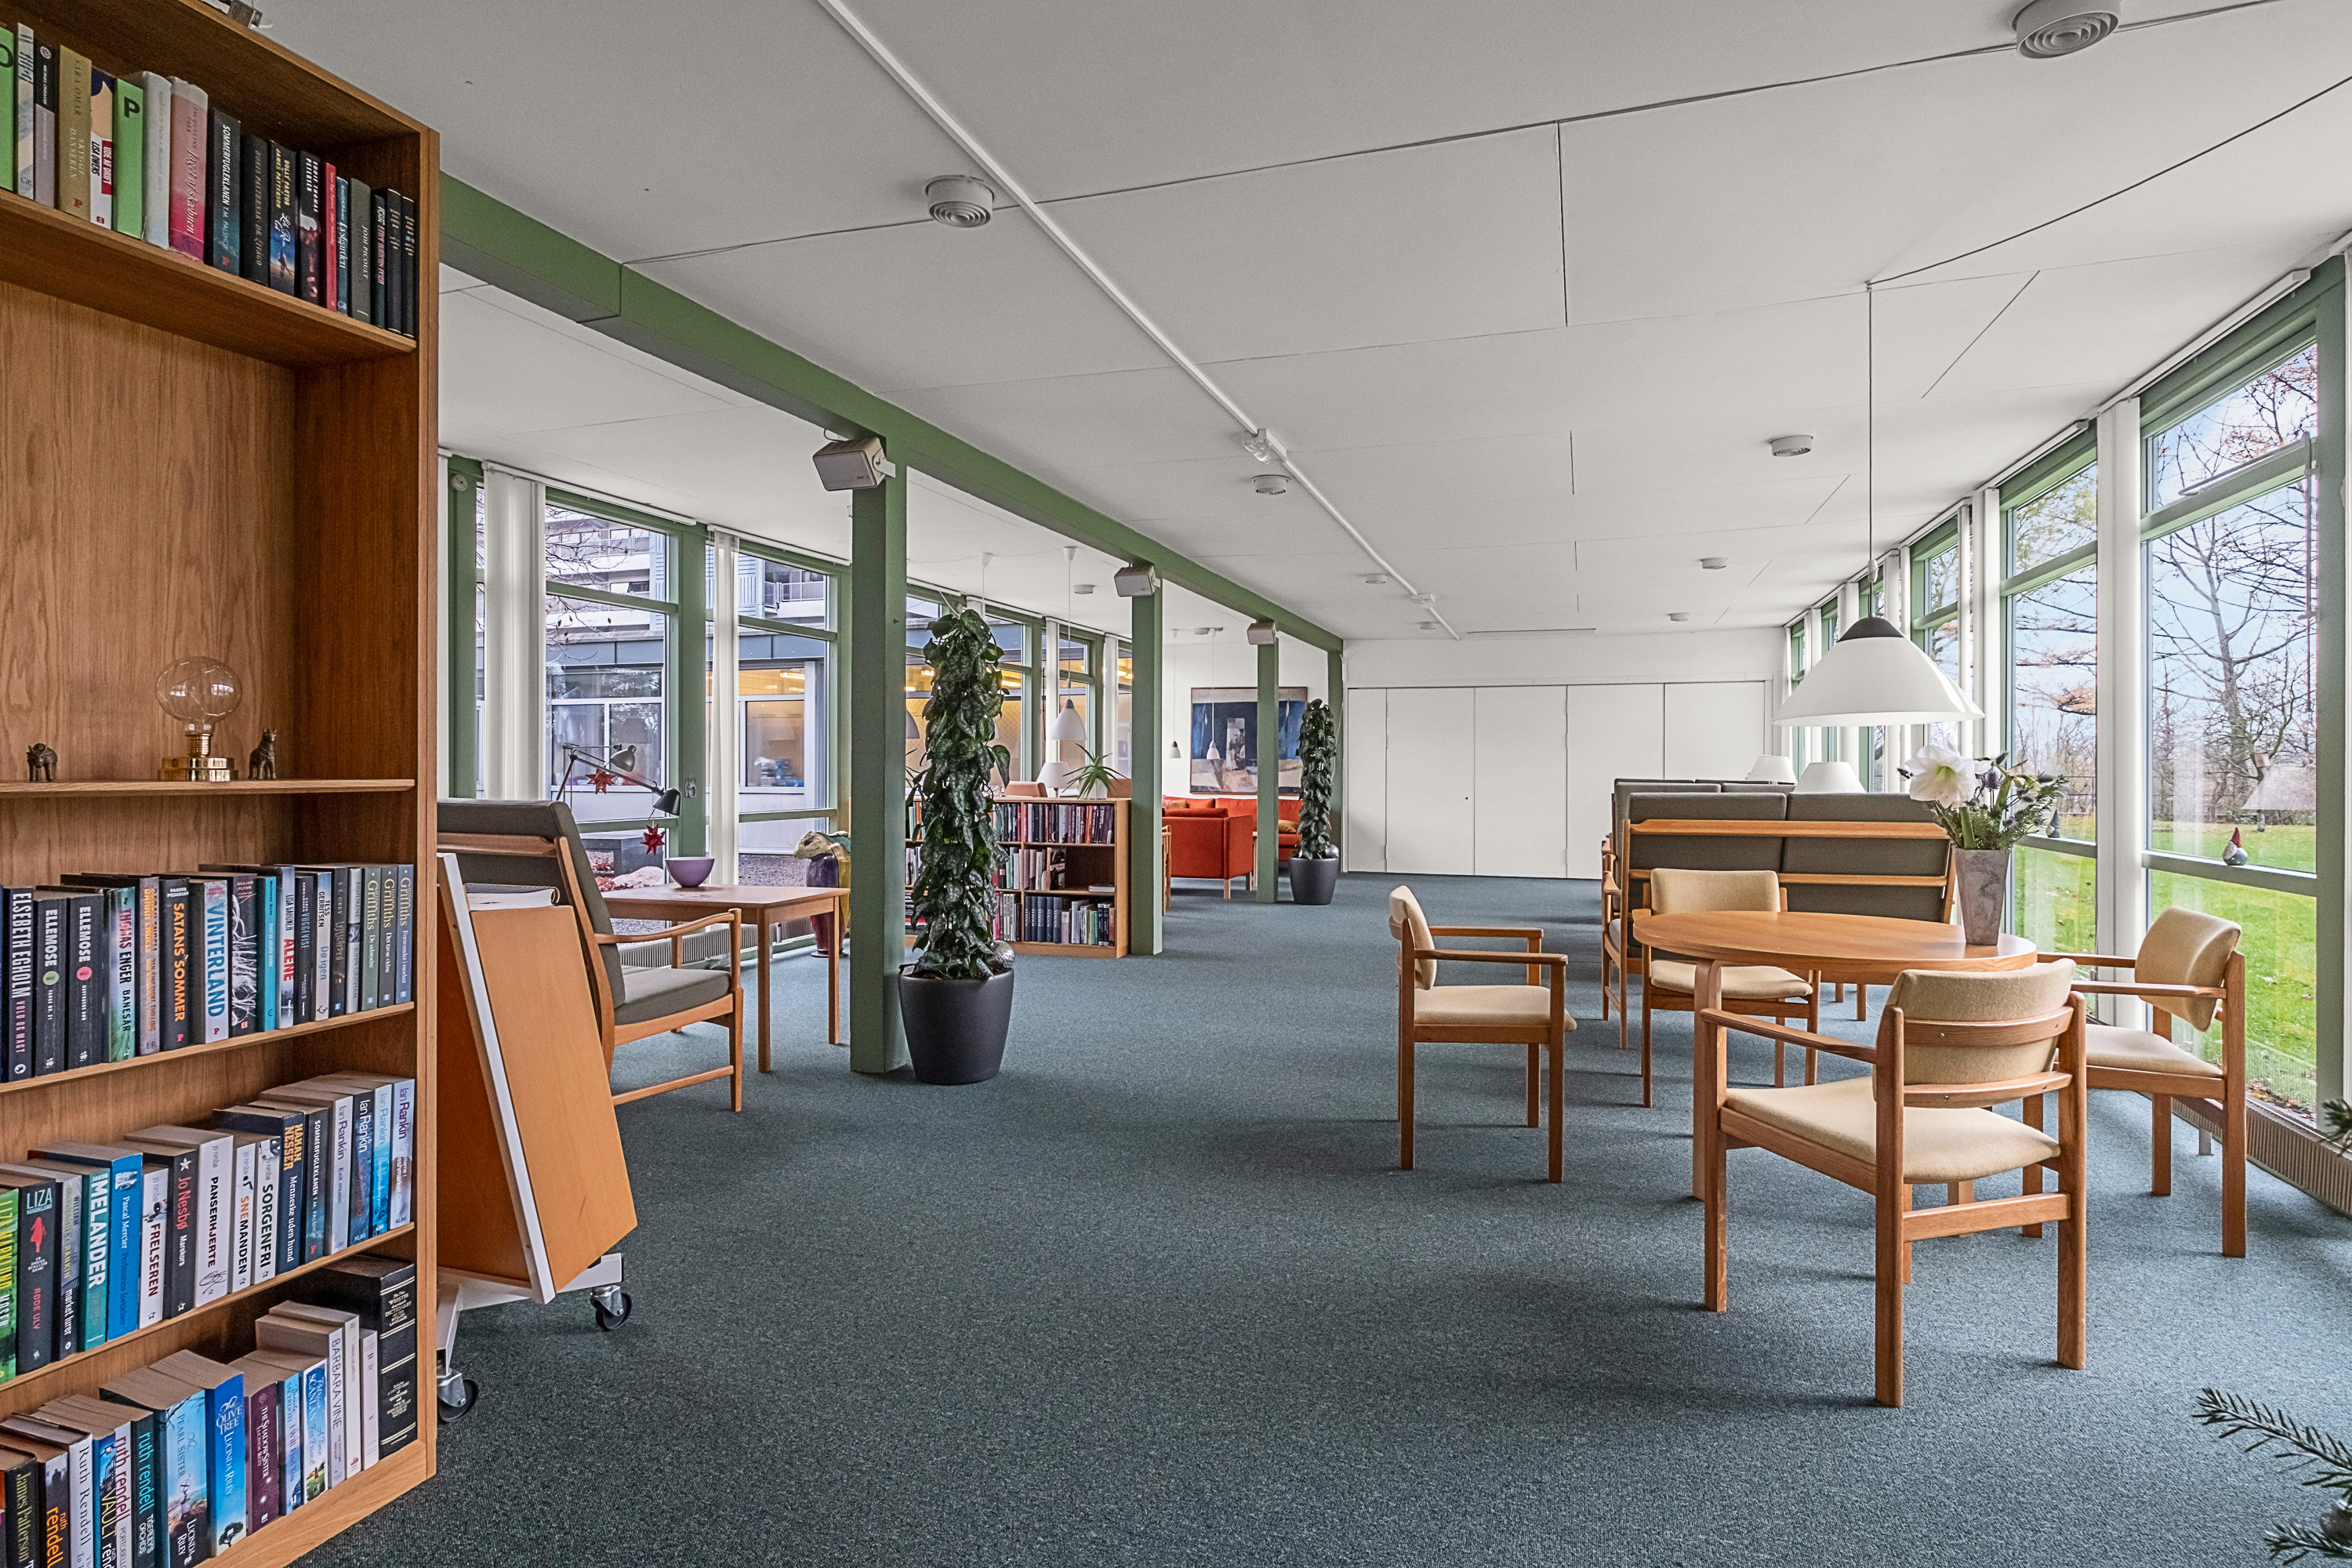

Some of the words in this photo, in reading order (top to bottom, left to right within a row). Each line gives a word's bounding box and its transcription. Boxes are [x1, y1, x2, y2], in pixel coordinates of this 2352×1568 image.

[124, 96, 141, 118] P
[92, 141, 100, 156] LISA
[92, 154, 100, 176] OWENS
[103, 146, 111, 158] UDE
[103, 158, 111, 166] AF
[185, 147, 199, 180] Jaget
[103, 166, 111, 185] DRIFT
[184, 177, 198, 196] af
[187, 191, 198, 234] skæbnen
[144, 888, 158, 920] SARAH
[285, 895, 294, 906] LISA
[366, 880, 379, 931] Griffiths
[383, 878, 395, 928] Griffiths
[400, 877, 411, 926] Griffiths
[12, 893, 31, 949] ELSEBETH
[78, 906, 91, 963] ELLEMOSE
[119, 908, 132, 949] THOMAS
[173, 902, 184, 956] SATANS
[285, 906, 294, 931] GARDNER
[301, 913, 310, 949] VUGGEVISE
[45, 909, 58, 967] ELLEMOSE
[144, 922, 158, 953] ENGELL
[369, 935, 376, 943] De
[12, 950, 31, 998] EGHOLM
[119, 951, 132, 984] ENGER
[146, 958, 156, 971] DEN
[207, 902, 225, 1017] VINTERLAND
[284, 938, 295, 982] ALENE
[318, 960, 328, 980] igen
[146, 970, 156, 1004] KINESISKE
[174, 960, 185, 1022] SOMMER
[16, 1000, 25, 1019] VOLD
[16, 1021, 25, 1031] OG
[146, 1004, 156, 1032] TVILLING
[16, 1033, 25, 1052] MAGT
[359, 1099, 371, 1116] Ian
[379, 1093, 388, 1108] Ian
[398, 1087, 409, 1102] Ian
[338, 1105, 347, 1120] Ian
[379, 1108, 388, 1145] Rankin
[398, 1102, 410, 1140] Rankin
[283, 1125, 295, 1171] NESSER
[337, 1120, 348, 1160] Rankin
[358, 1115, 371, 1153] Rankin
[312, 1120, 321, 1196] SOMMERFUGLEKLANEN
[27, 1187, 53, 1210] LIZA
[178, 1176, 192, 1189] Jo
[289, 1175, 298, 1216] Menneske
[26, 1203, 53, 1215] MARKLUND
[122, 1196, 130, 1220] Pascal
[176, 1189, 191, 1230] Nesbø
[208, 1176, 219, 1268] PANSERHJERTE
[89, 1178, 108, 1290] MELANDER
[238, 1196, 249, 1275] SNEMANDEN
[260, 1184, 274, 1268] SORGENFRI
[288, 1218, 296, 1240] uden
[354, 1232, 366, 1241] KLIM
[148, 1223, 161, 1298] FRELSEREN
[179, 1234, 188, 1266] Marekors
[287, 1239, 296, 1263] hund
[121, 1251, 129, 1292] Perlmanns
[119, 1292, 128, 1325] fortielser
[385, 1300, 412, 1317] DICTIONARY
[64, 1315, 74, 1336] lurer
[332, 1338, 341, 1400] BARBARA
[218, 1396, 238, 1416] The
[308, 1373, 317, 1421] SCANLAN
[315, 1376, 325, 1410] Patricia
[177, 1413, 186, 1445] PEARL
[216, 1404, 243, 1427] OLIVE
[220, 1416, 241, 1436] TREE
[332, 1398, 342, 1430] VINE
[116, 1436, 131, 1468] ruth
[139, 1431, 154, 1463] ruth
[177, 1445, 186, 1479] SISTER
[224, 1431, 234, 1472] LUCINDA
[79, 1446, 91, 1484] Ruth
[16, 1472, 31, 1509] James
[116, 1471, 131, 1523] rendell
[139, 1464, 154, 1515] rendell
[225, 1470, 234, 1495] RILEY
[60, 1512, 68, 1530] ruth
[79, 1487, 92, 1547] Rendell
[17, 1505, 32, 1563] Patterson
[46, 1506, 64, 1568] rendell
[177, 1533, 187, 1556] RILEY
[187, 1518, 197, 1558] LUCINDA
